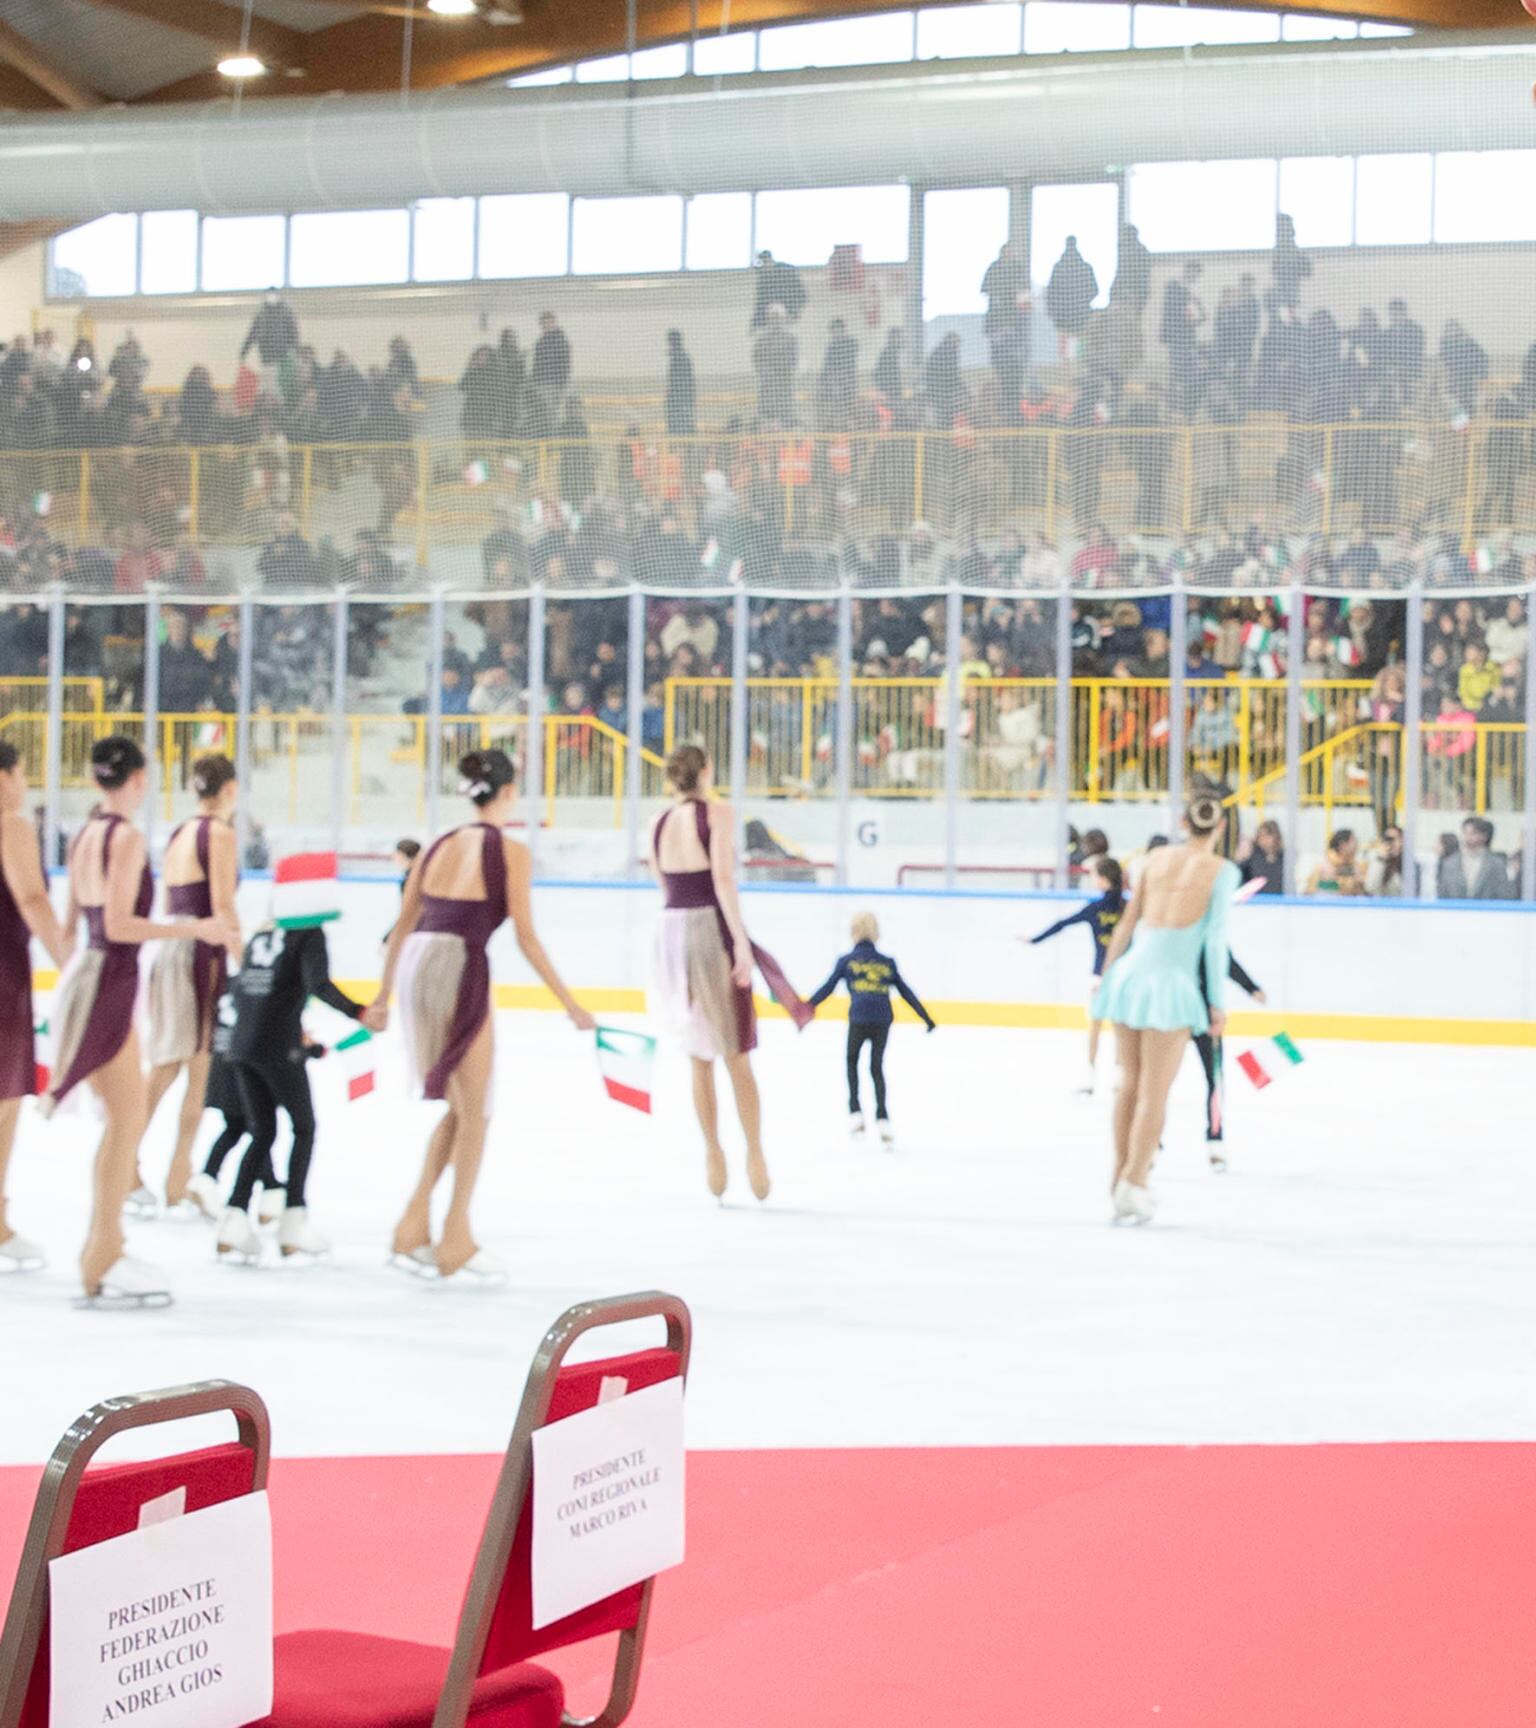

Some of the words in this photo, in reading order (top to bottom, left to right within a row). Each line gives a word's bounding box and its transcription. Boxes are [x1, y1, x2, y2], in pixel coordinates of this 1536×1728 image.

[858, 820, 878, 848] G
[557, 1495, 589, 1520] CONI
[590, 1466, 661, 1507] REGIONALE
[573, 1449, 646, 1490] PRESIDENTE
[569, 1509, 616, 1539] MARCO
[618, 1498, 648, 1520] RIVA
[108, 1578, 217, 1631] PRESIDENTE
[100, 1604, 225, 1664] FEDERAZIONE
[118, 1639, 209, 1686] GHIACCIO
[102, 1683, 176, 1724] ANDREA
[180, 1664, 223, 1694] GIOS
